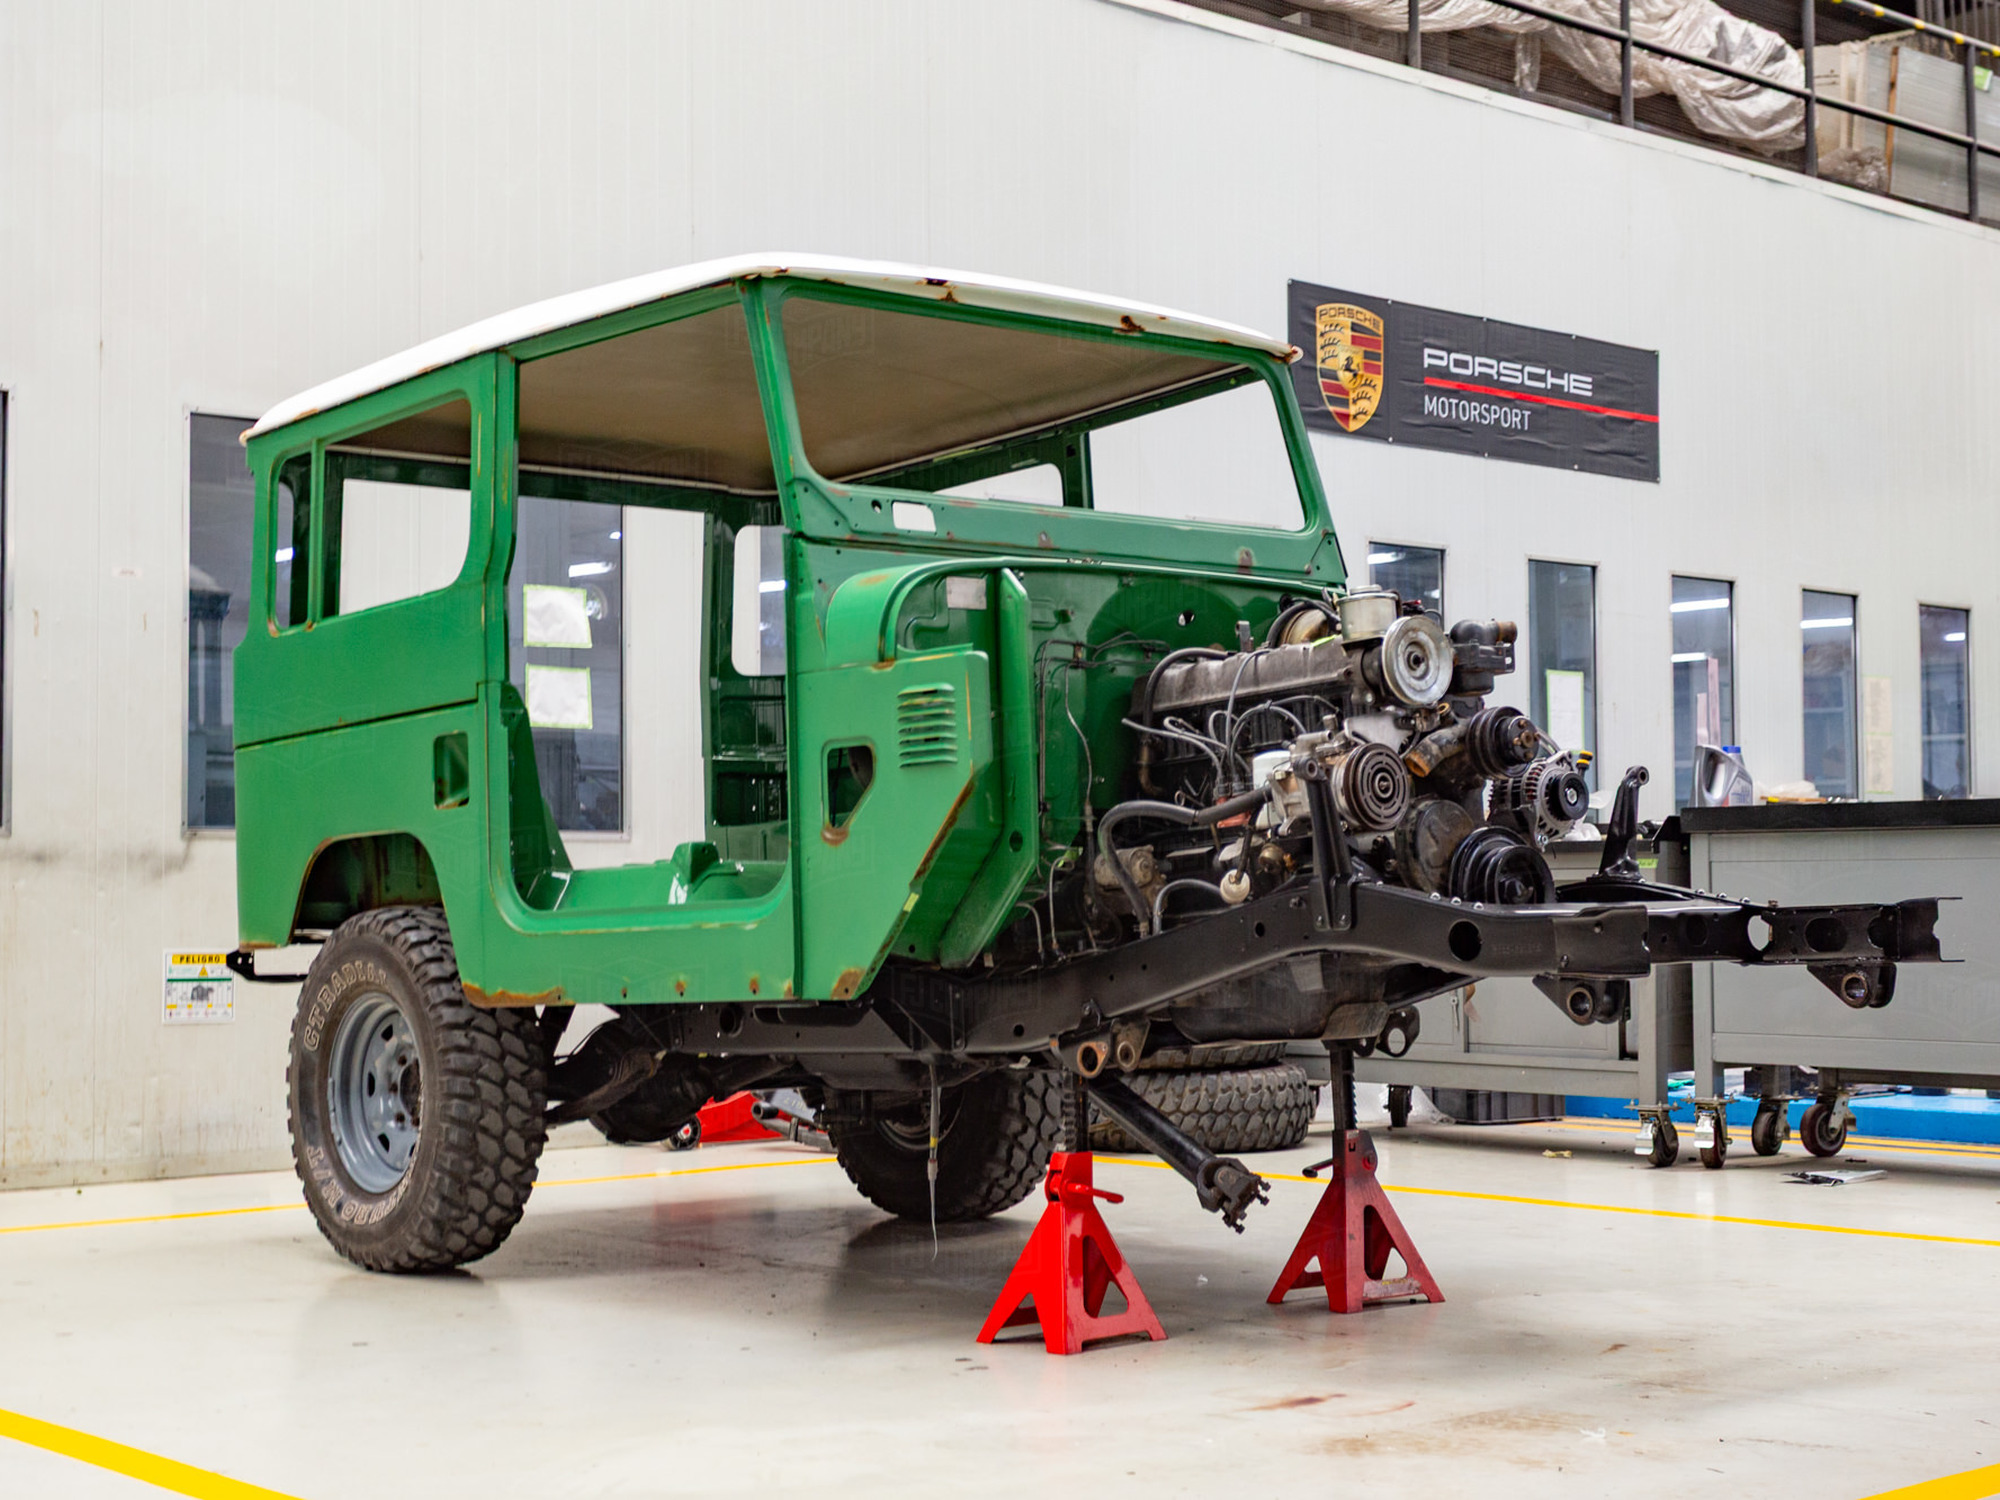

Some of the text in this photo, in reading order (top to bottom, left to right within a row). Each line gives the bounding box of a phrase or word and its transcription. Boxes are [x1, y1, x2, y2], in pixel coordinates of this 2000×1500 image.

[1318, 306, 1381, 331] PORSCHE
[1424, 347, 1593, 397] PORSCHE
[1424, 394, 1531, 431] MOTORSPORT
[179, 955, 221, 964] PELIGRO
